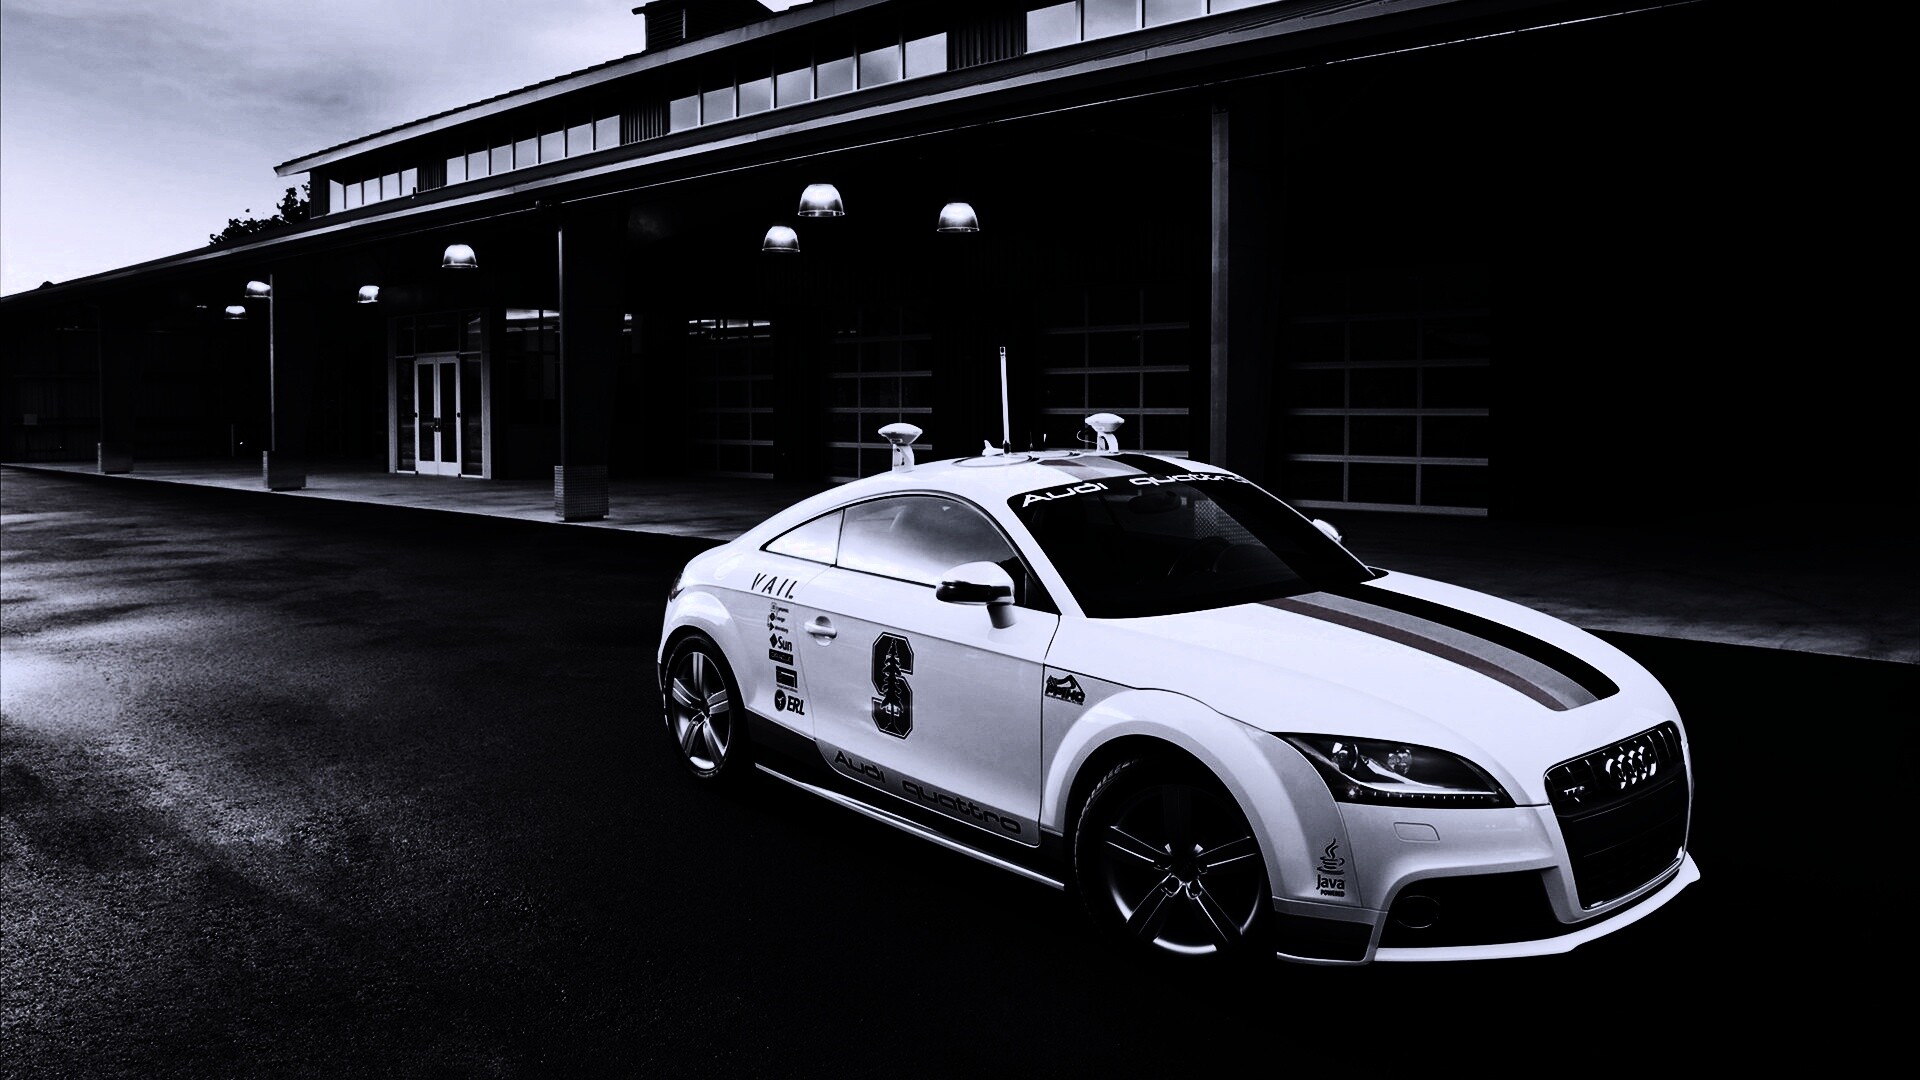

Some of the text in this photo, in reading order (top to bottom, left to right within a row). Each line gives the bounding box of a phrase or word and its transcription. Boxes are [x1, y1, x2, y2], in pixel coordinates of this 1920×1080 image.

[1022, 482, 1108, 507] Audi
[751, 572, 797, 599] VAIL
[777, 635, 792, 652] Sun
[786, 695, 805, 715] ERL
[834, 751, 1021, 834] Audi quattro
[1316, 874, 1345, 890] Java
